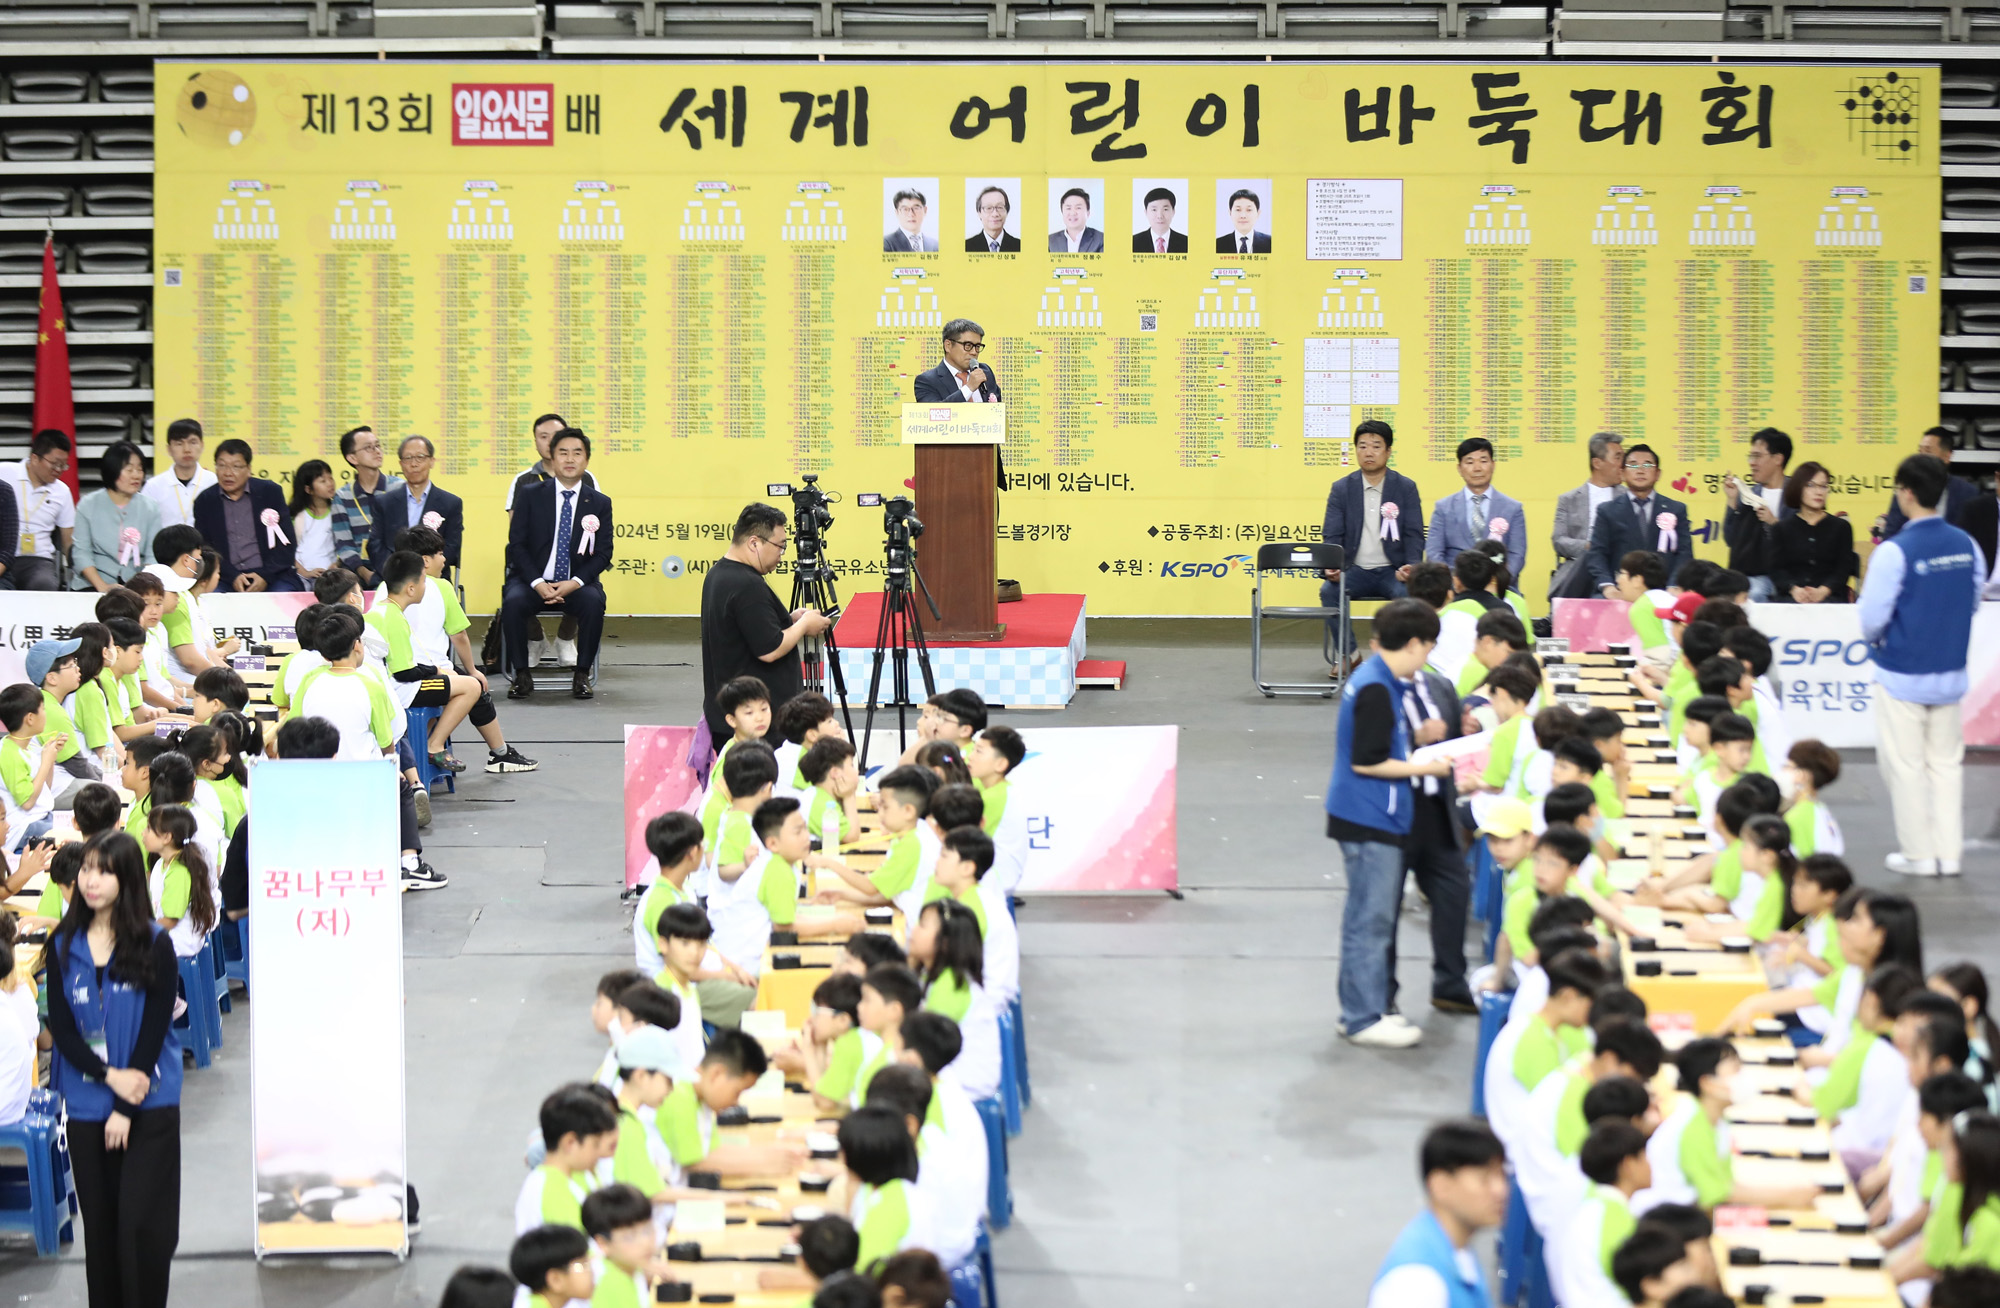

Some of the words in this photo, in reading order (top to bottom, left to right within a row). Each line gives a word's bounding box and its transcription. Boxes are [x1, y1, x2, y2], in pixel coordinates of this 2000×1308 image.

[301, 93, 432, 135] 제13회
[454, 89, 549, 140] 일요신문
[566, 94, 600, 135] 배
[660, 85, 869, 150] 세계
[949, 79, 1260, 162] 어린이
[1344, 71, 1773, 165] 바둑대회
[1058, 472, 1135, 492] 있습니다.
[613, 524, 659, 540] 024년
[666, 523, 690, 540] 5월
[1112, 560, 1144, 576] 후원
[1160, 561, 1229, 578] KSPO
[1766, 635, 1869, 667] SPO
[262, 868, 388, 899] 꿈나무부
[296, 907, 351, 938] (저)
